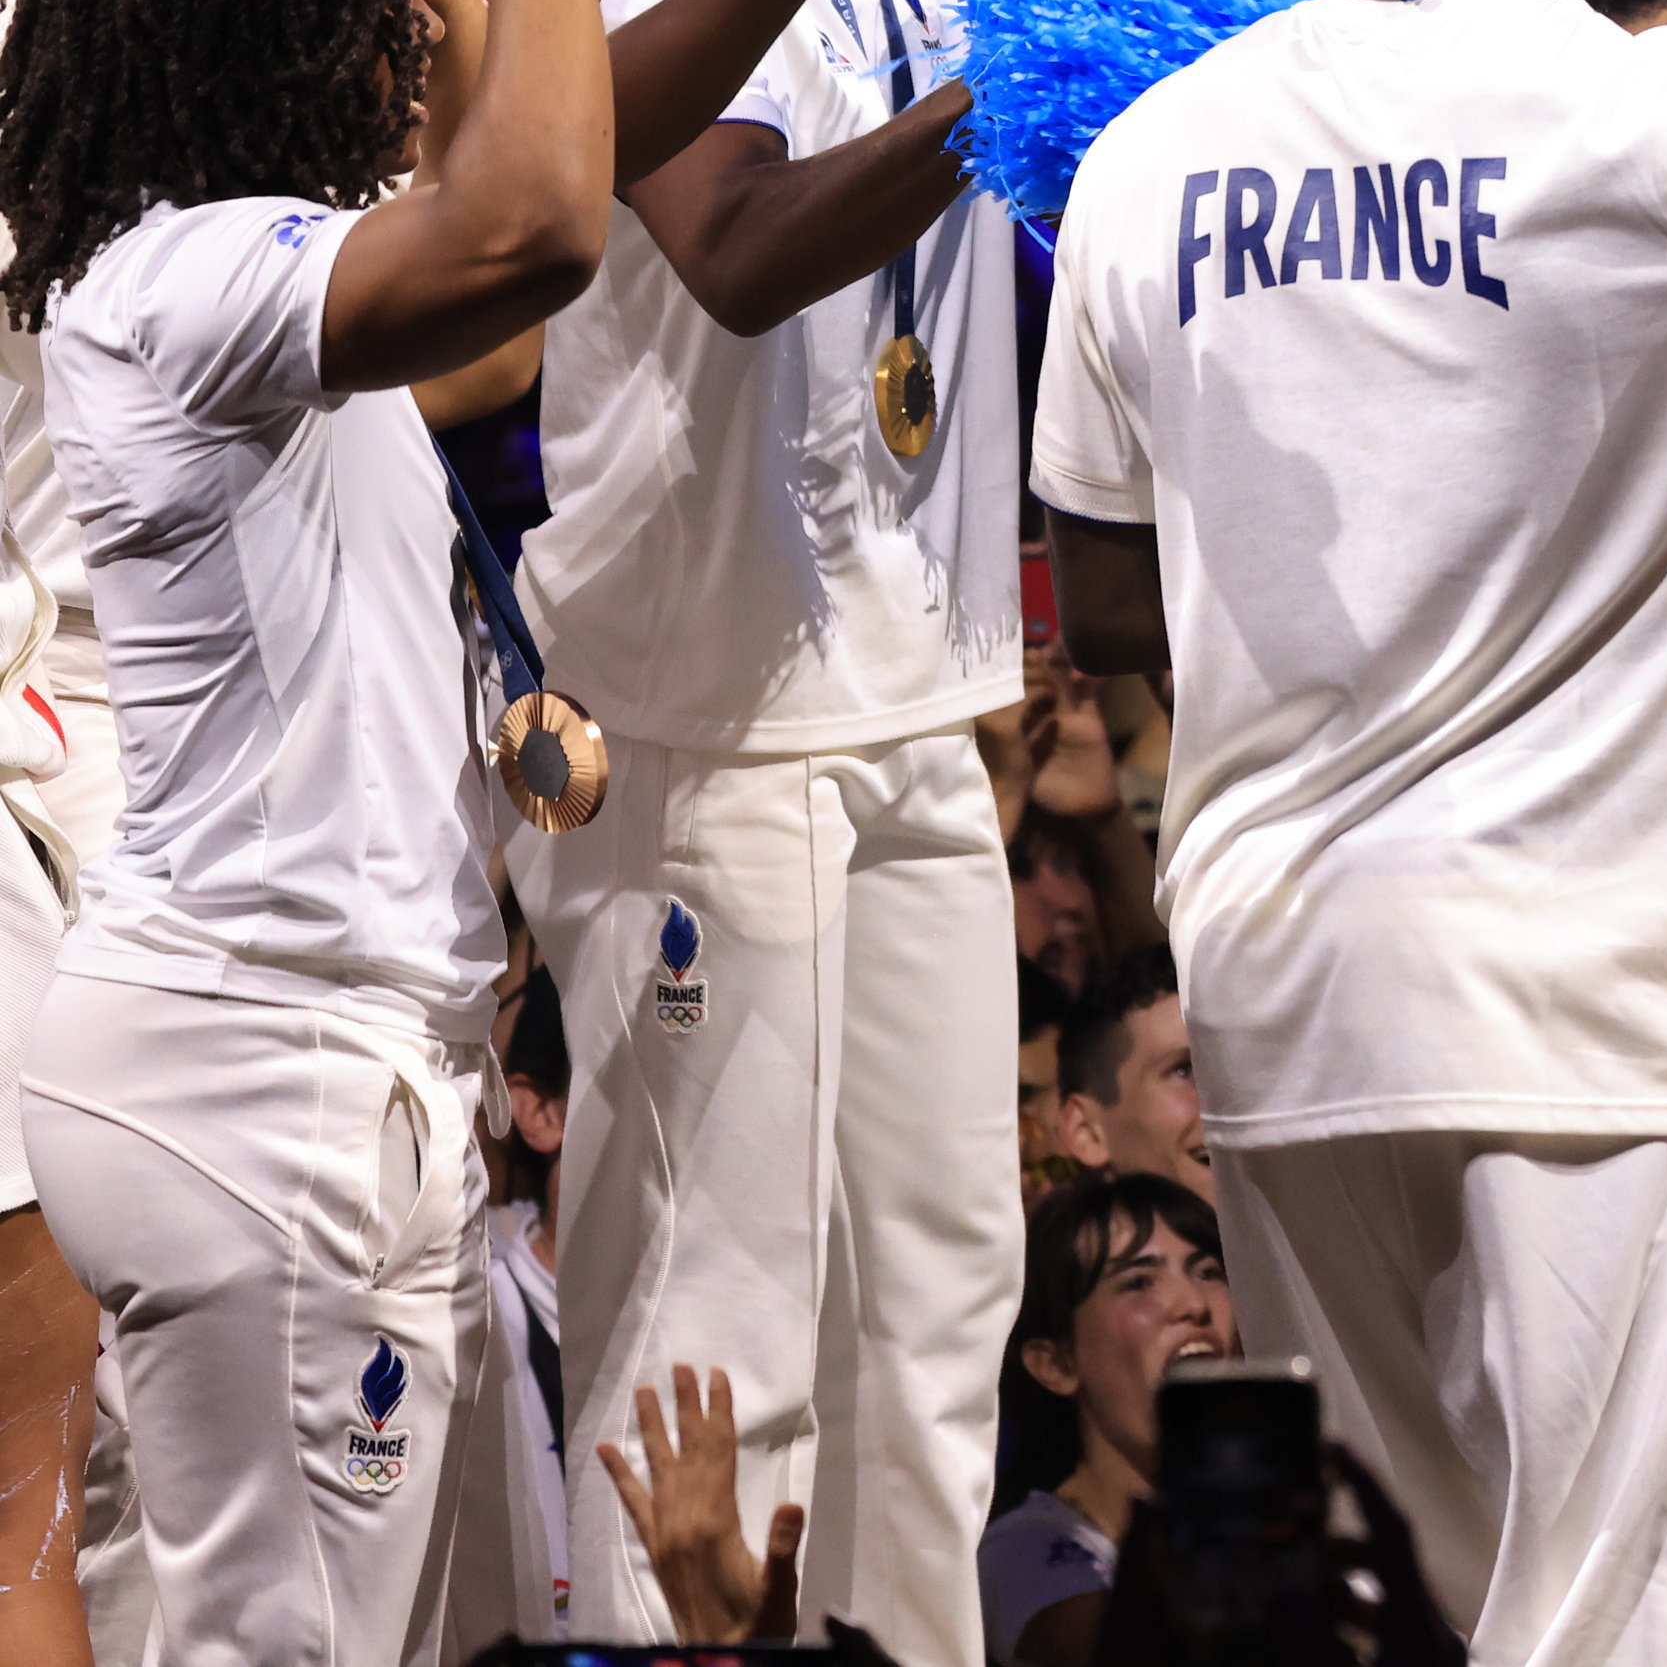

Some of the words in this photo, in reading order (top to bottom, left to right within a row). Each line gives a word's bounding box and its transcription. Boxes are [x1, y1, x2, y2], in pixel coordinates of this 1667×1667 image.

[1178, 157, 1510, 329] FRANCE
[657, 984, 704, 1004] FRANCE
[349, 1433, 406, 1458] FRANCE
